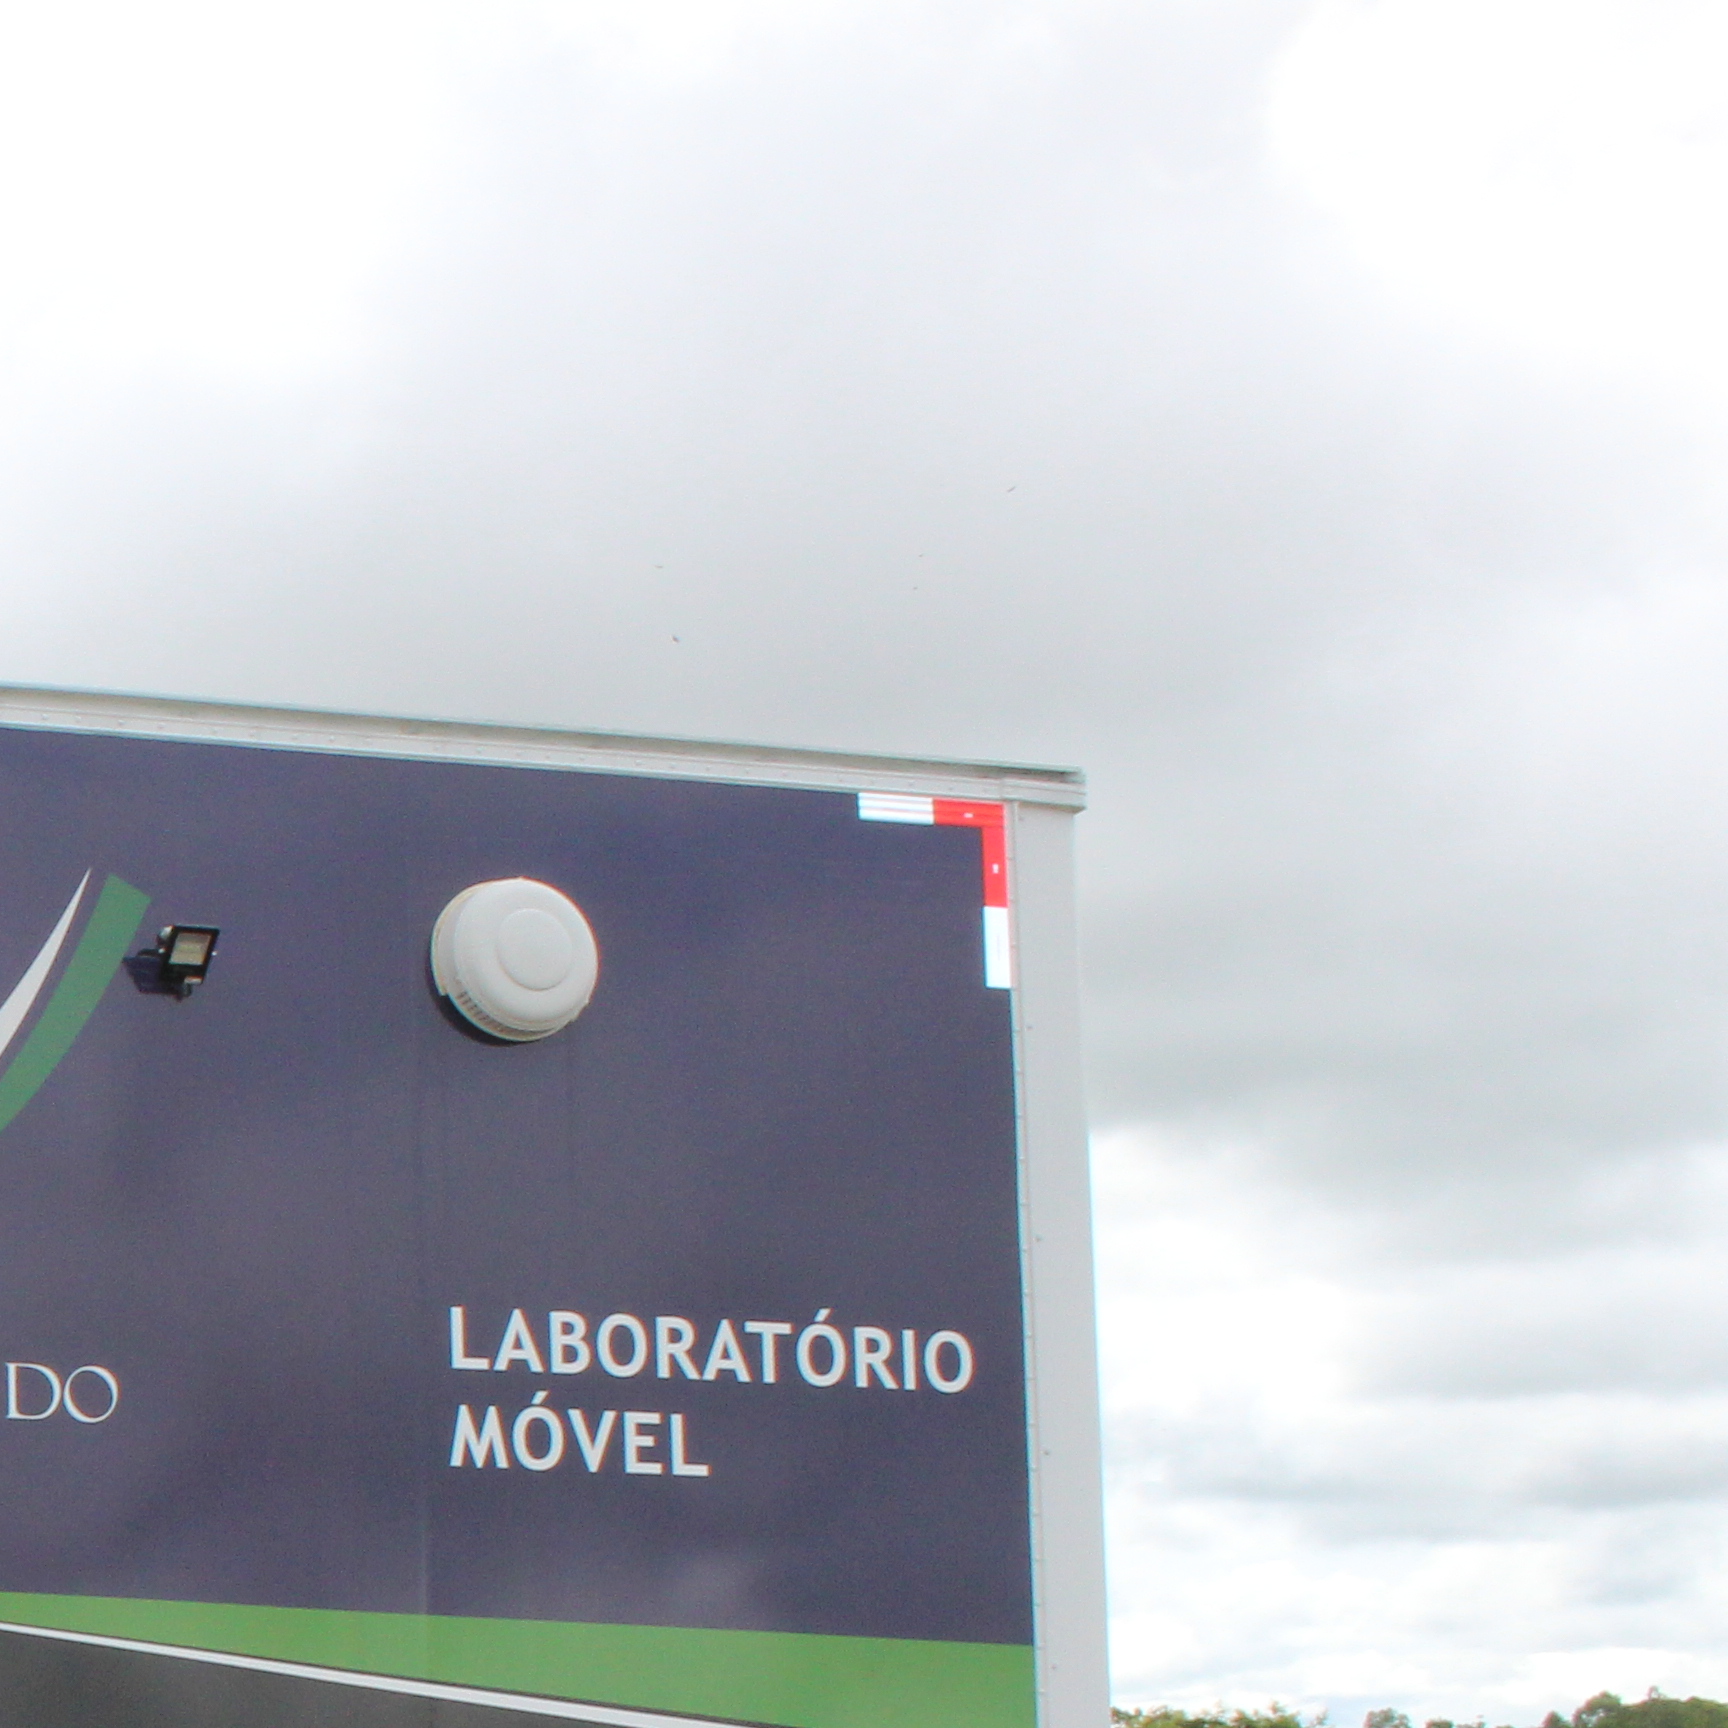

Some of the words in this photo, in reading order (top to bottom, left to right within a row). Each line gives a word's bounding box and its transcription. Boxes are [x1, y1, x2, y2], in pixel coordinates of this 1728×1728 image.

[5, 1362, 120, 1424] DO
[449, 1306, 974, 1394] LABORATÓRIO
[449, 1390, 710, 1478] MÓVEL
